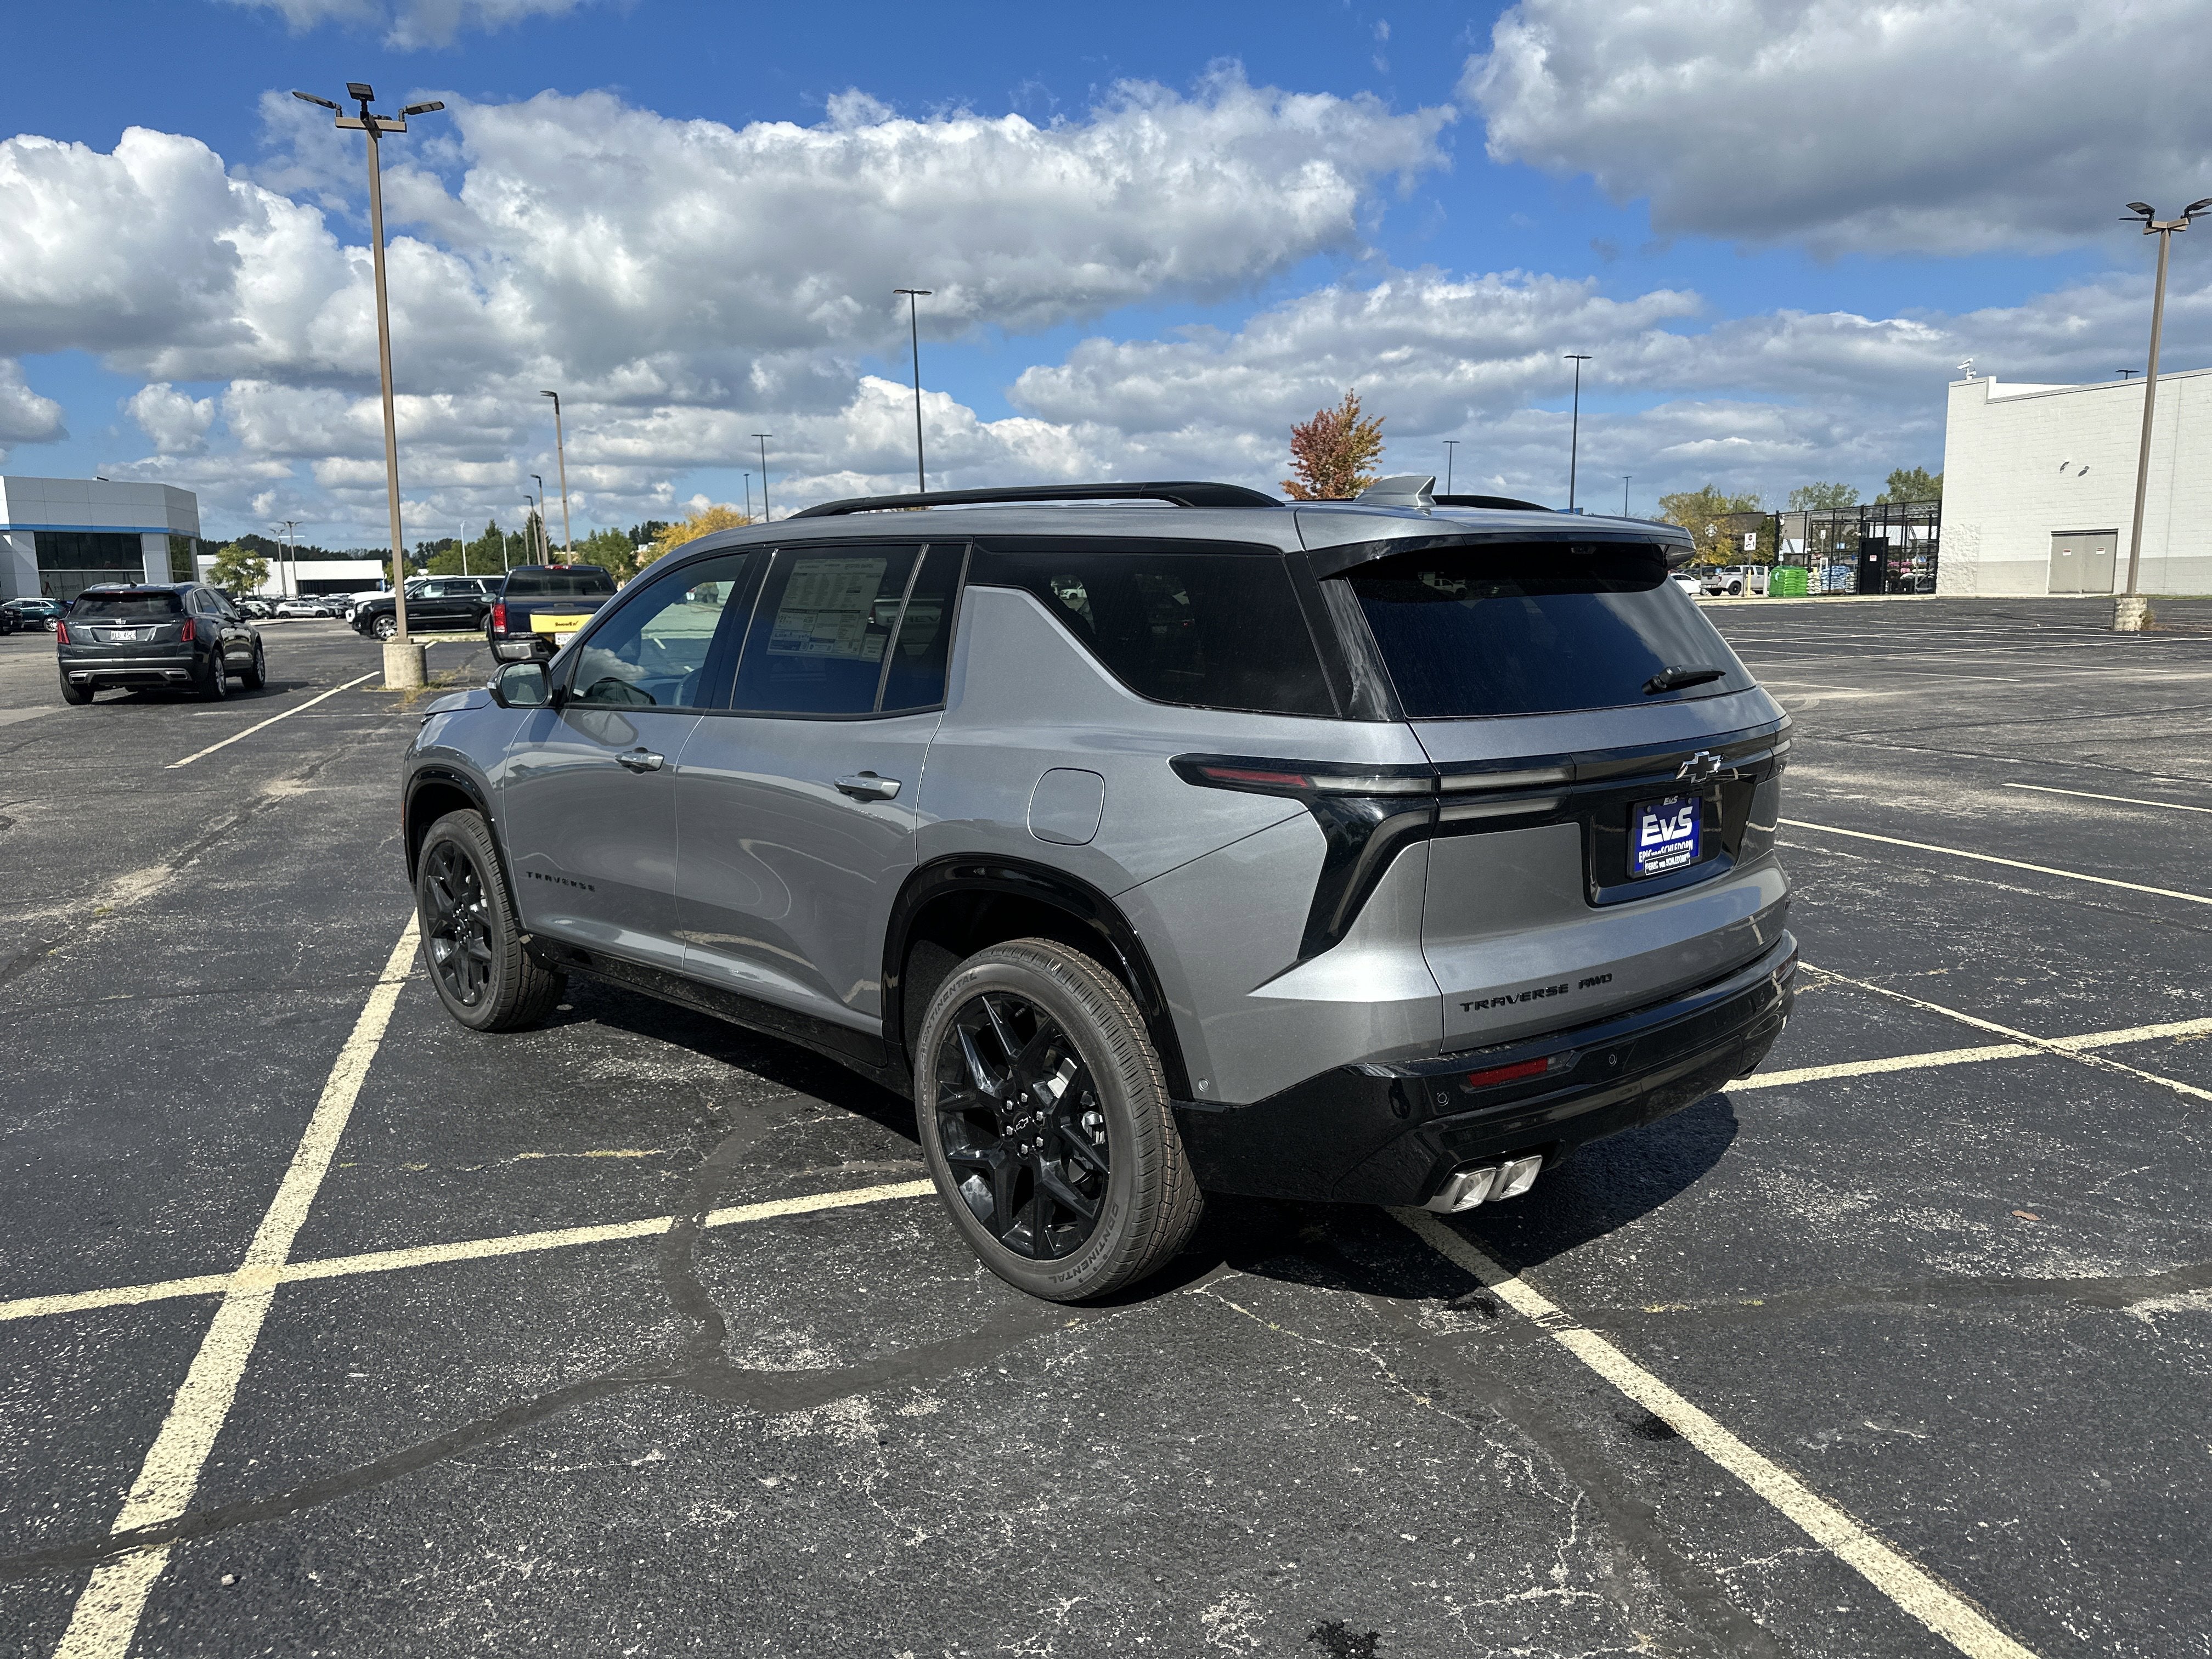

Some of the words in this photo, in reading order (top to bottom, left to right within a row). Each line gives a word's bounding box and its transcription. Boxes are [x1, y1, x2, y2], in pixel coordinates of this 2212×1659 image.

[526, 871, 596, 892] TRAVERSE
[1459, 983, 1569, 1013] TRAVERSE
[1578, 972, 1613, 990] AWD
[1048, 1201, 1119, 1284] CONTINENTAL
